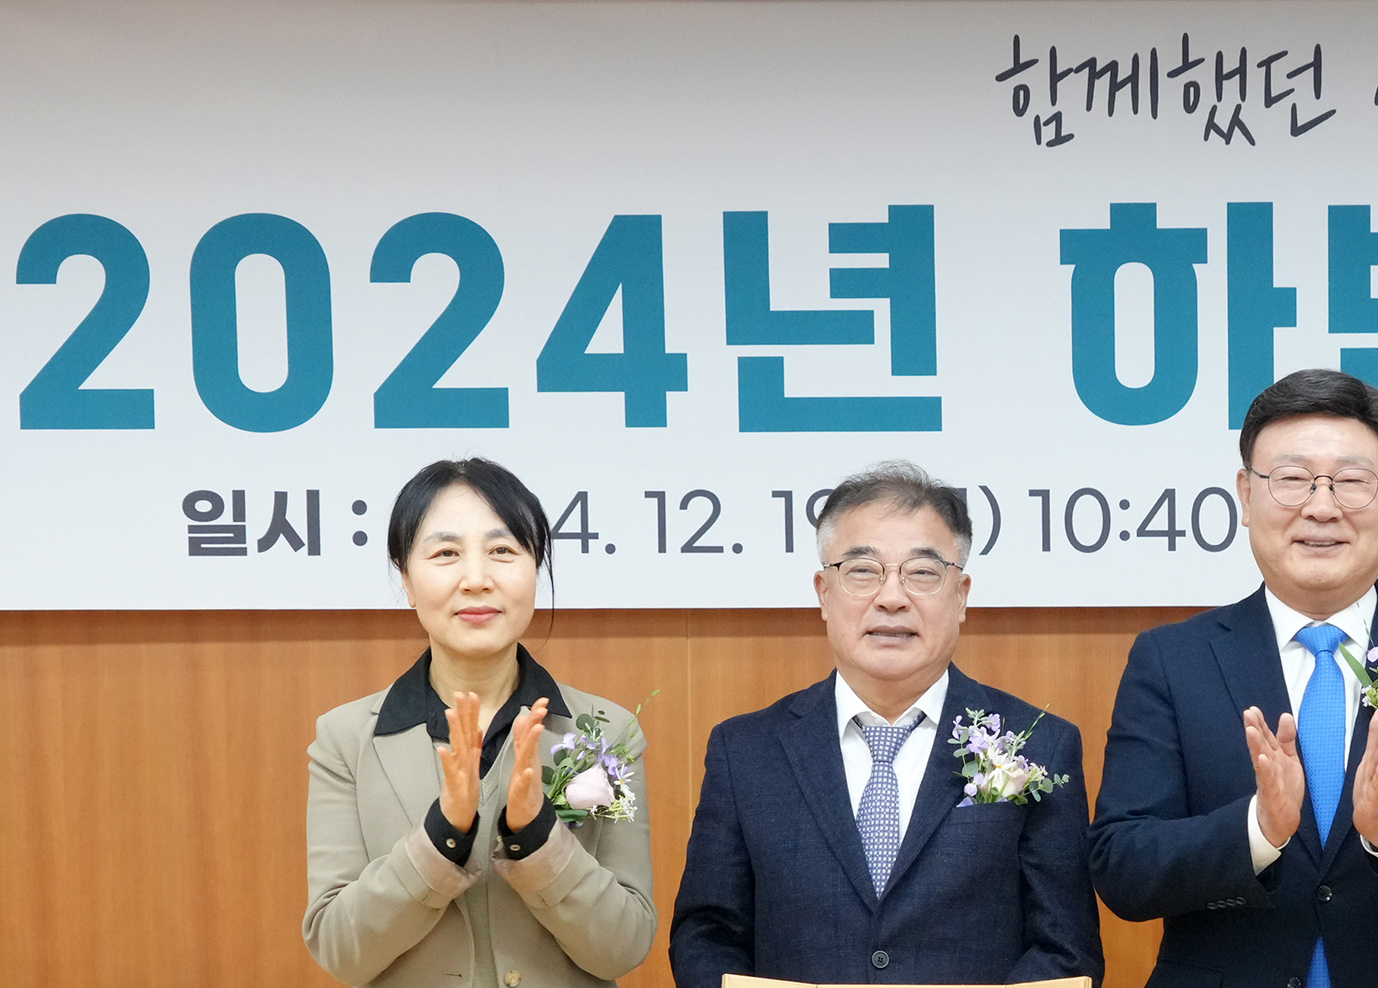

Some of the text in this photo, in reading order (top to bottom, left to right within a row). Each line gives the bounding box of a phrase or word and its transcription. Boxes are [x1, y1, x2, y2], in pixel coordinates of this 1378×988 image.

[994, 32, 1337, 148] 함께했던
[16, 204, 943, 433] 2024년
[182, 489, 321, 557] 일시
[1028, 486, 1238, 554] 10:40
